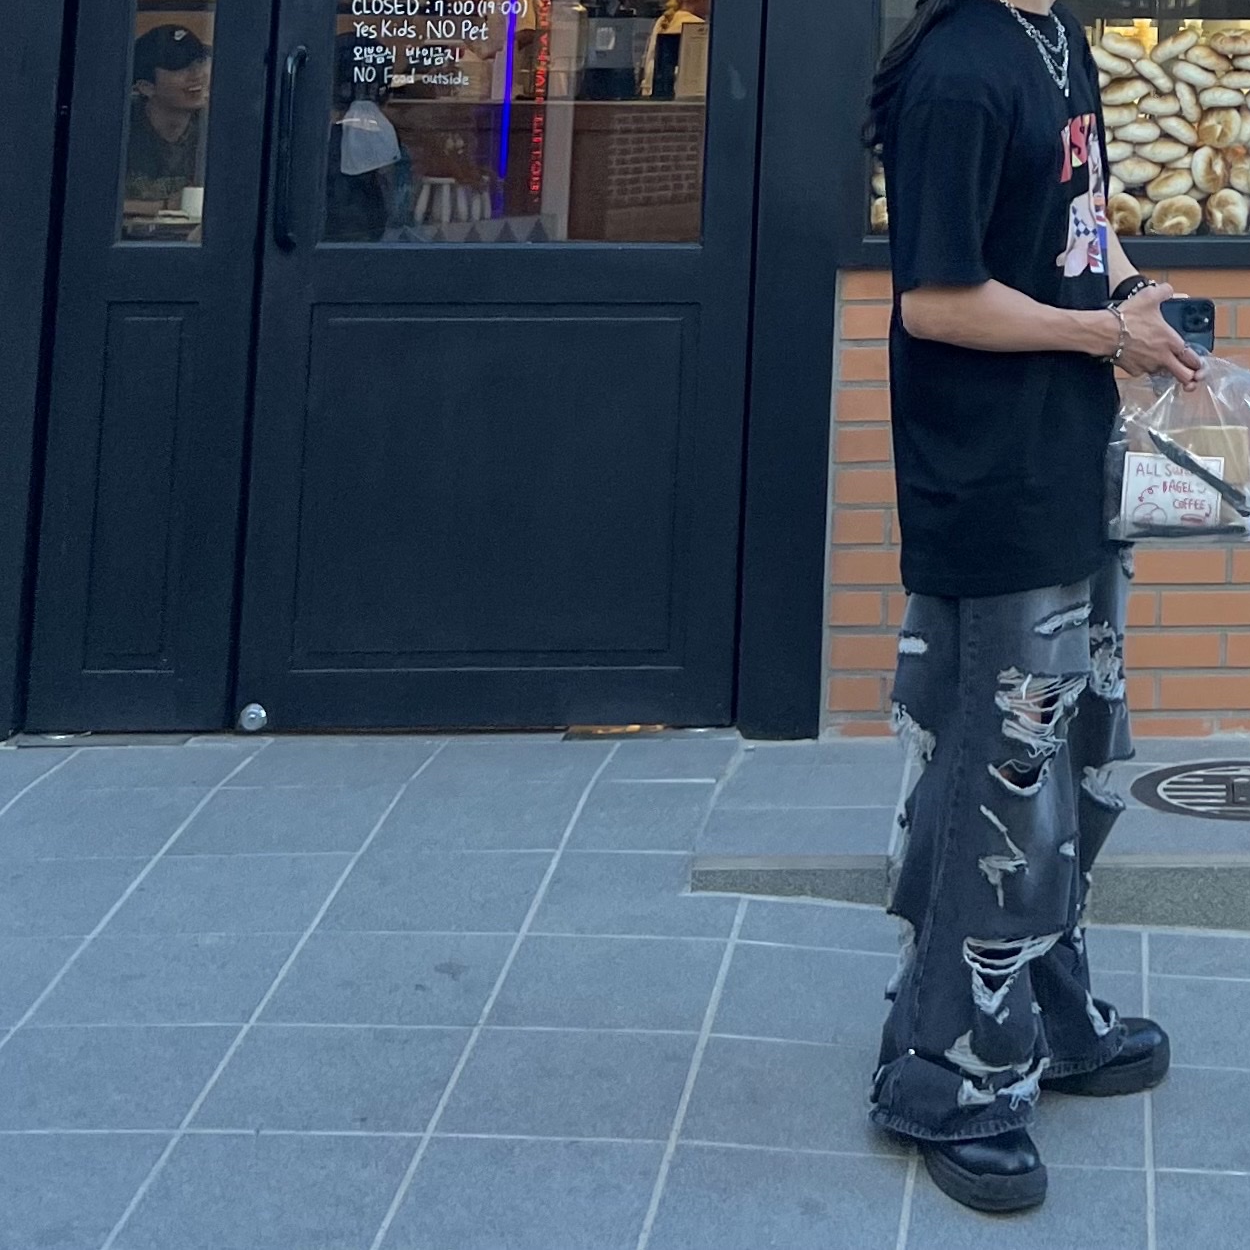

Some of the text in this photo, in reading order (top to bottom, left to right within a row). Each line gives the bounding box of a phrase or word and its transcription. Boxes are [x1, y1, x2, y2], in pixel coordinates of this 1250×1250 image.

[353, 21, 378, 39] Yes
[426, 20, 456, 39] NO
[461, 19, 489, 40] Pet
[405, 45, 460, 66] 반입금지
[353, 66, 471, 86] NO Food outside
[1135, 461, 1162, 478] ALL
